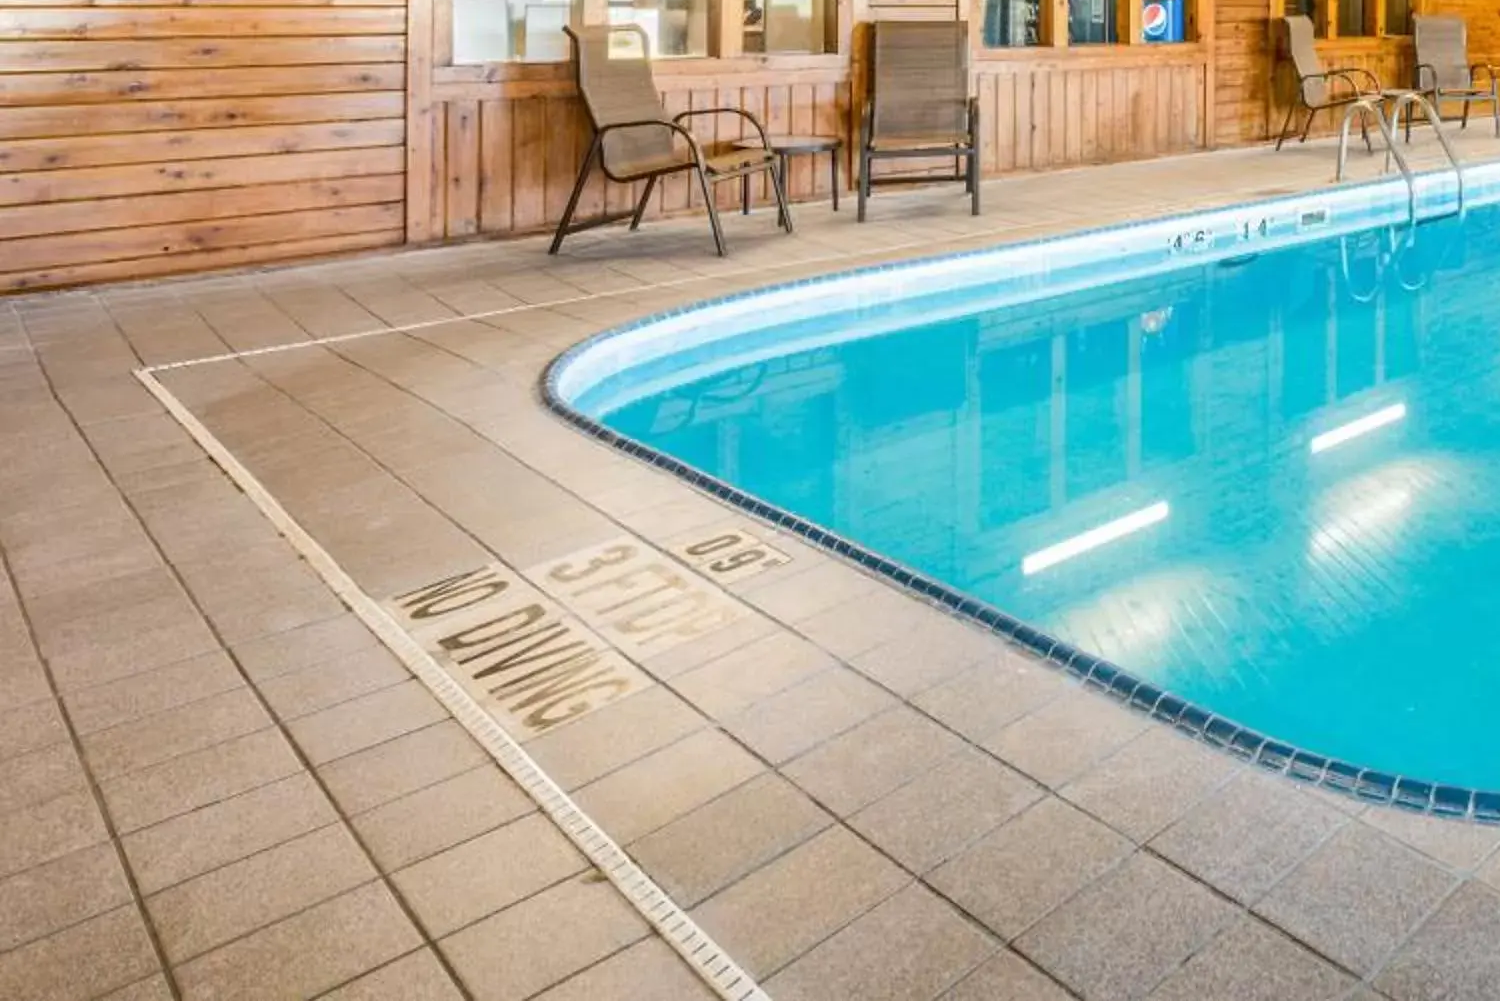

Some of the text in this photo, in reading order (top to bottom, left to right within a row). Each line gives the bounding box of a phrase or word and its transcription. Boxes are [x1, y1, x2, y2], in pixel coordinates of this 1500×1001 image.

[392, 564, 510, 620] NO
[547, 545, 640, 583] 3
[436, 603, 631, 733] DIVING
